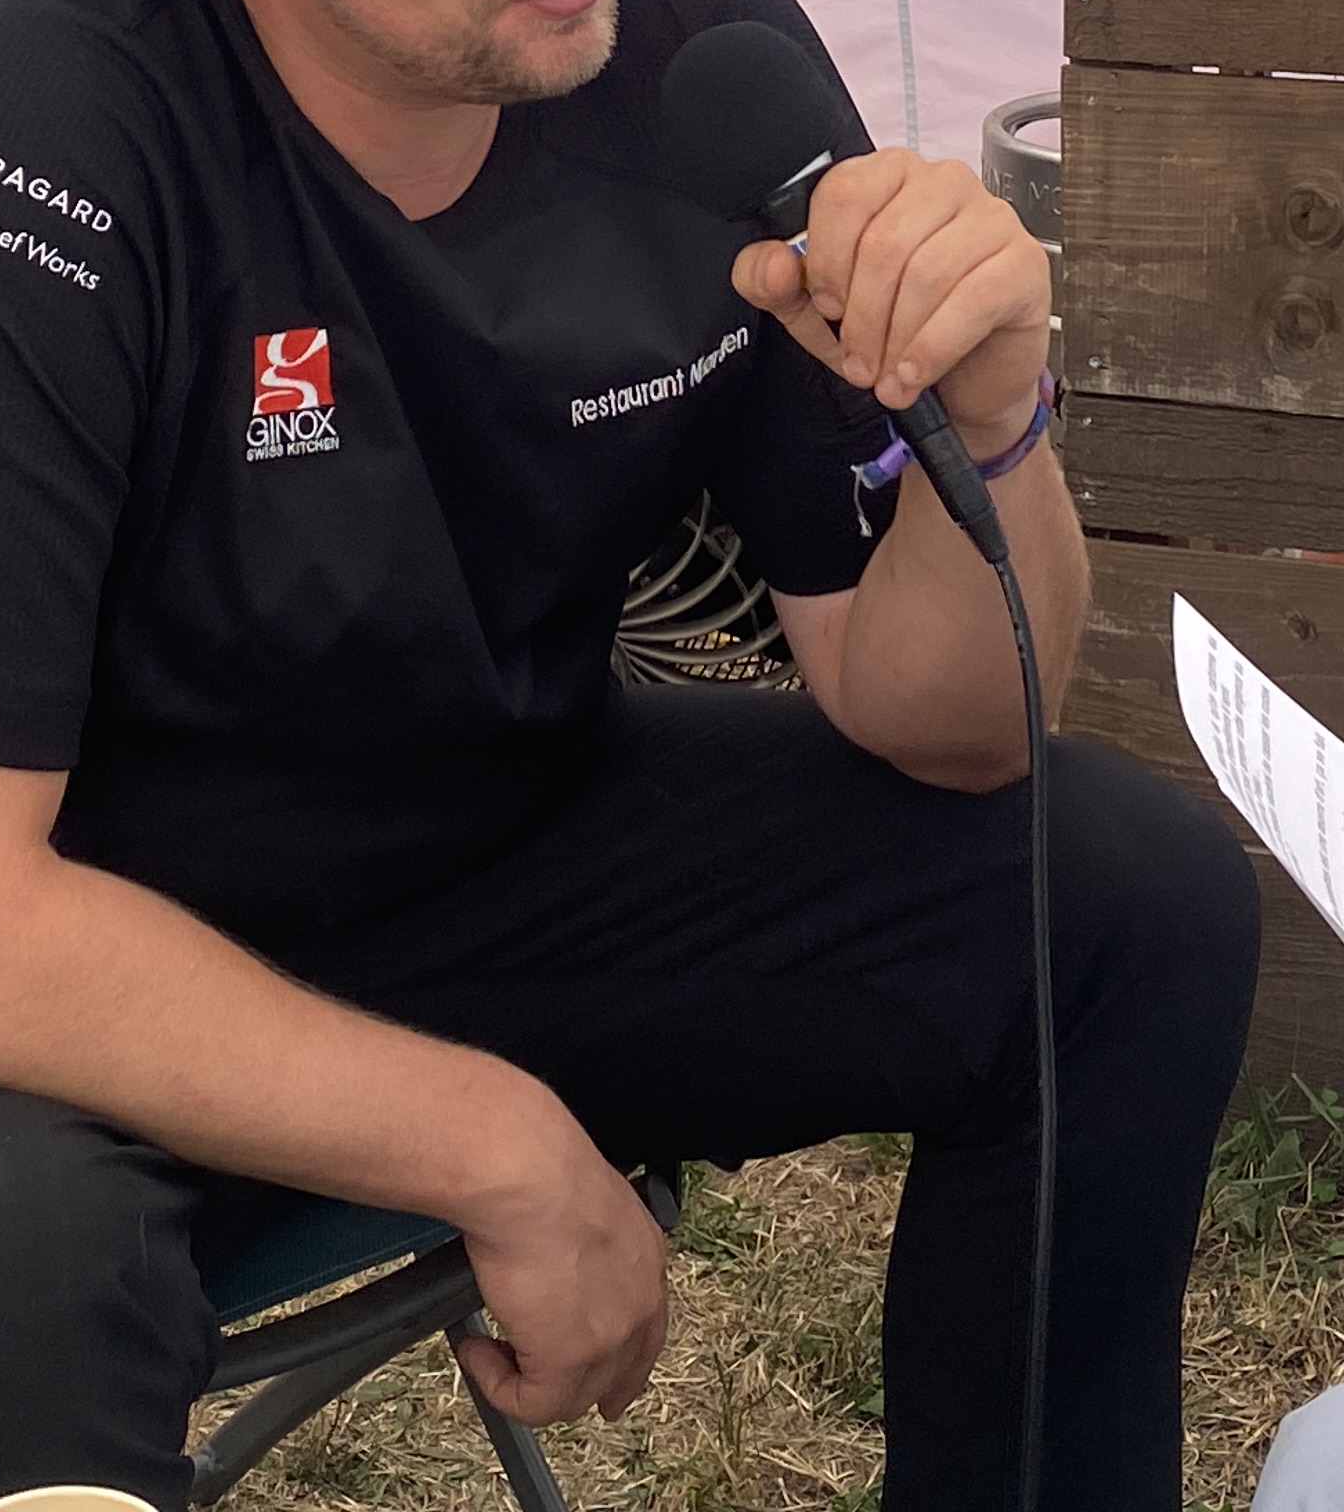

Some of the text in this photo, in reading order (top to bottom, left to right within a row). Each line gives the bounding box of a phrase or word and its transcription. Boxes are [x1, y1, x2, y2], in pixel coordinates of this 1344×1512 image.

[570, 367, 686, 428] Restaurant
[246, 407, 337, 448] GINOX
[246, 436, 340, 462] SWISS KITCHEN
